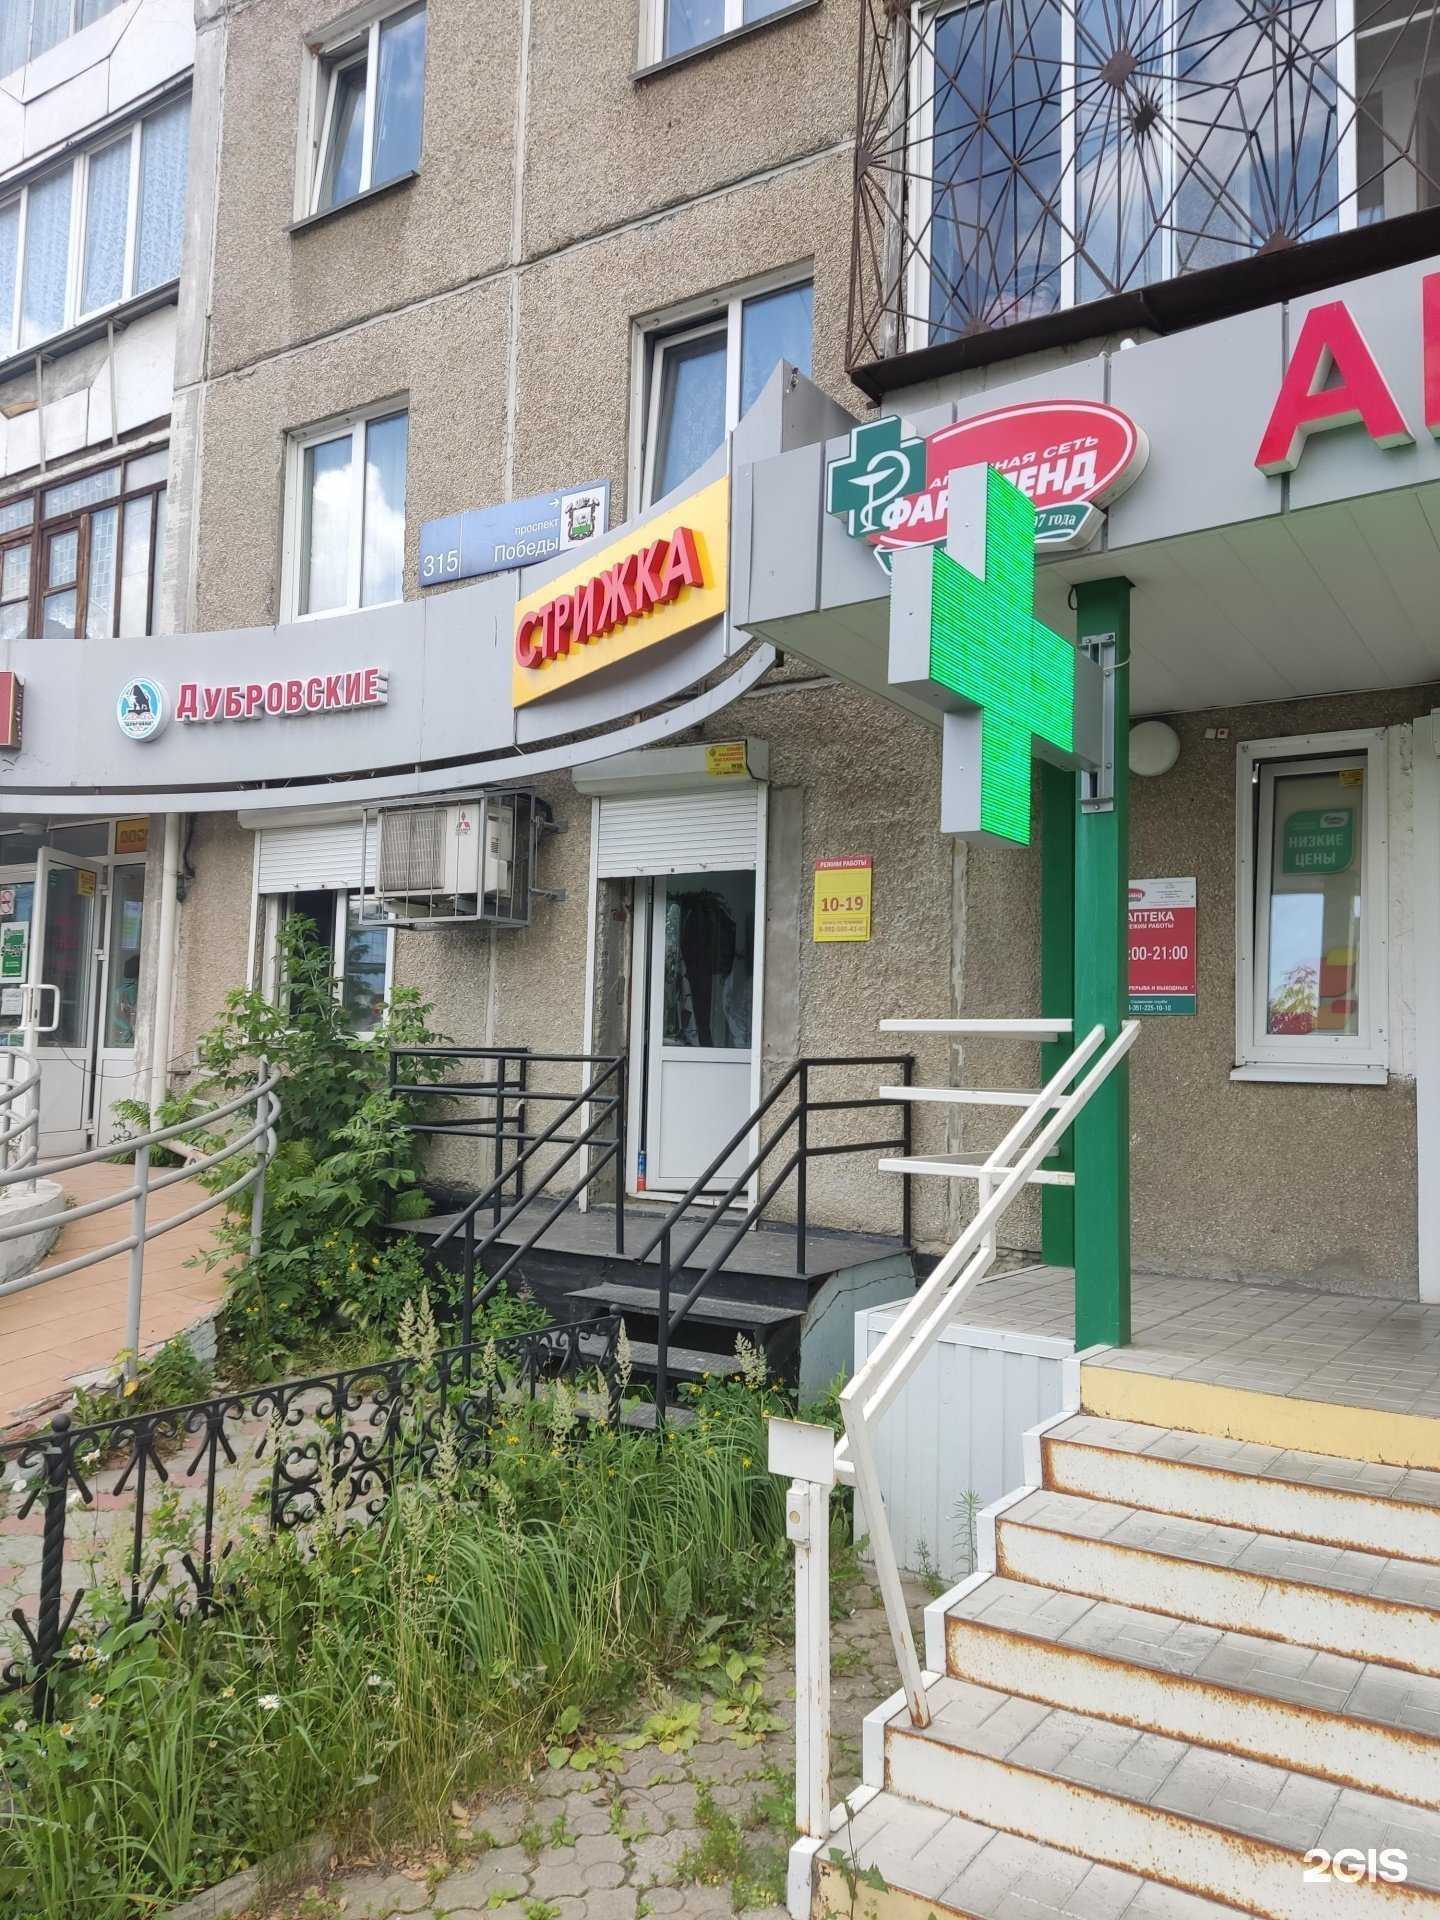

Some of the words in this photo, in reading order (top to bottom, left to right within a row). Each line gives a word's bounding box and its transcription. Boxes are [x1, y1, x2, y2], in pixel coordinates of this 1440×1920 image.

[1254, 272, 1440, 474] А
[1042, 436, 1099, 458] СЕТЬ
[515, 518, 560, 536] проспект
[1048, 513, 1077, 527] года
[423, 550, 459, 577] 315
[493, 537, 560, 563] Победы
[516, 526, 704, 669] СТРИЖКА
[175, 665, 388, 724] ДУБРОВСКИЕ
[1288, 833, 1344, 848] НИЗКИЕ
[843, 860, 867, 868] РАБОТЫ
[1295, 852, 1336, 868] ЦЕНЫ
[821, 896, 864, 912] 10-19
